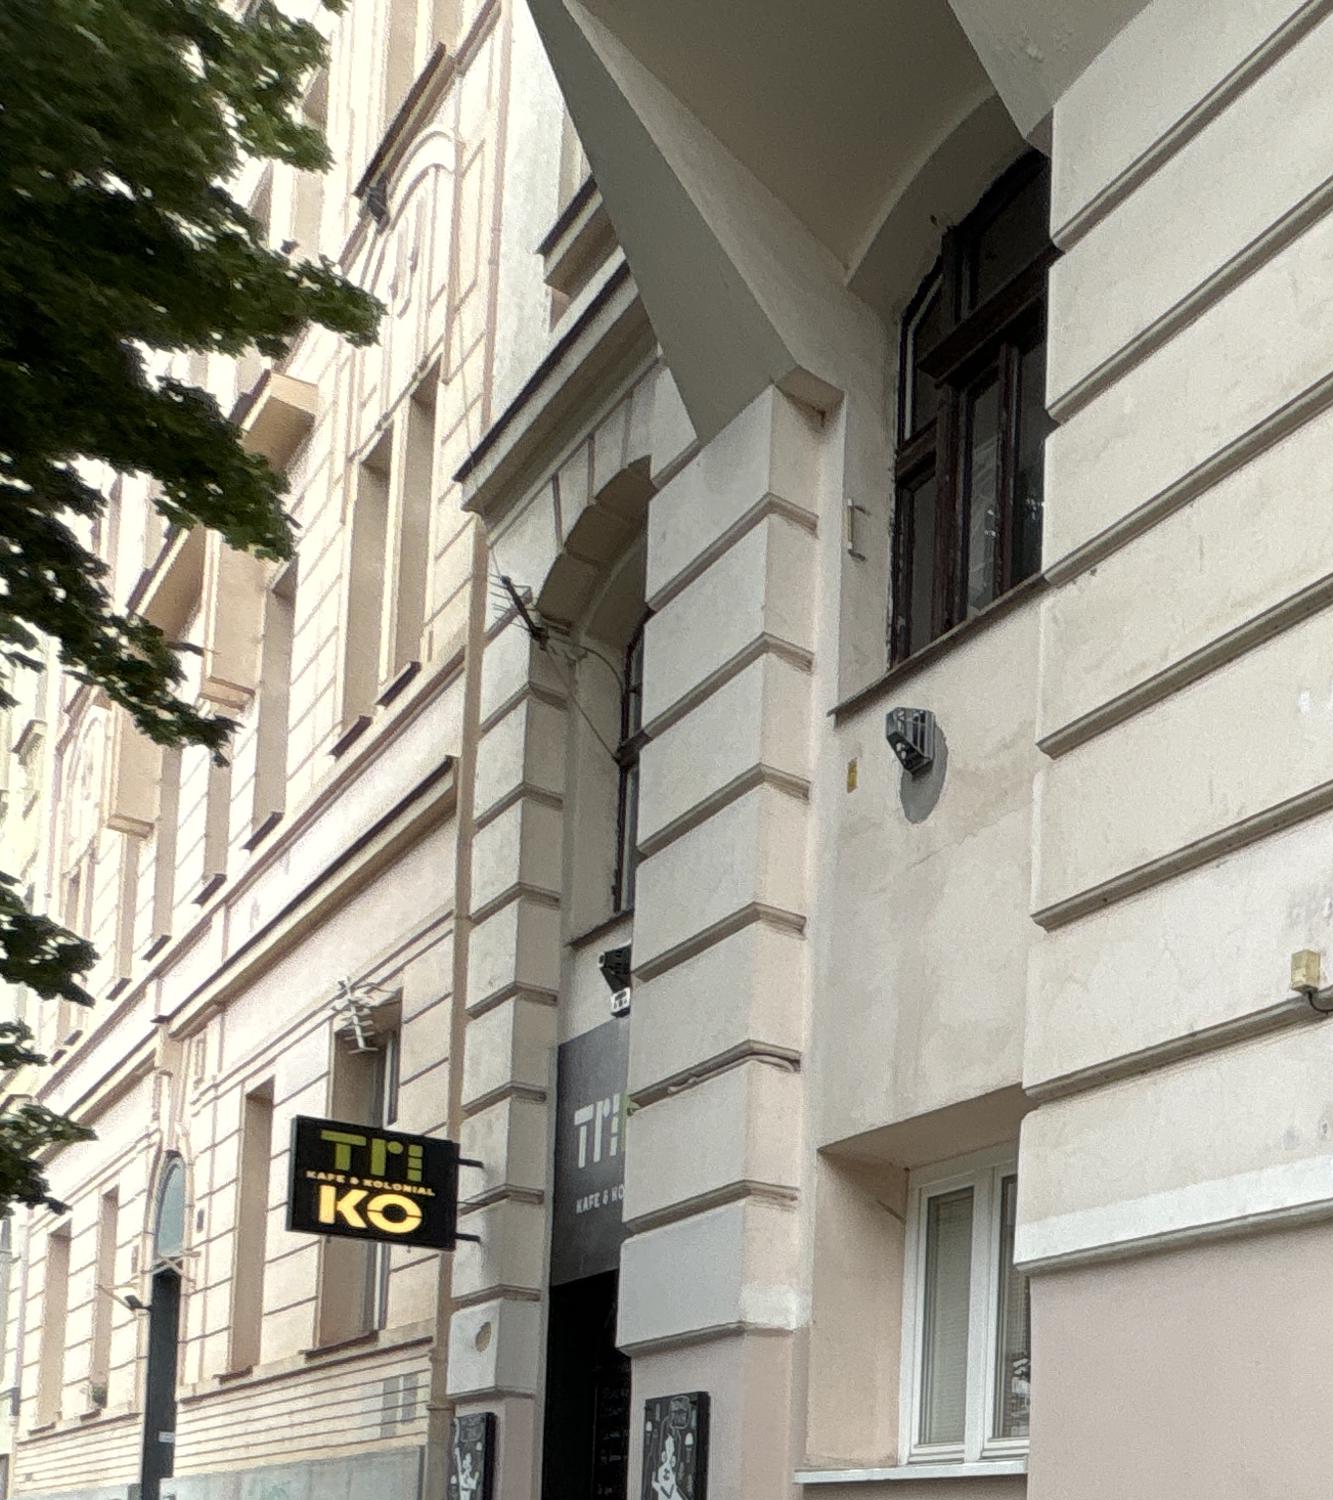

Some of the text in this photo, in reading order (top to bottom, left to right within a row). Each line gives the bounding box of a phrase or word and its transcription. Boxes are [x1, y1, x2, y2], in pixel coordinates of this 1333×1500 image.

[305, 1170, 345, 1183] KAFE
[363, 1178, 435, 1196] KOLONIAL
[318, 1184, 423, 1234] KO
